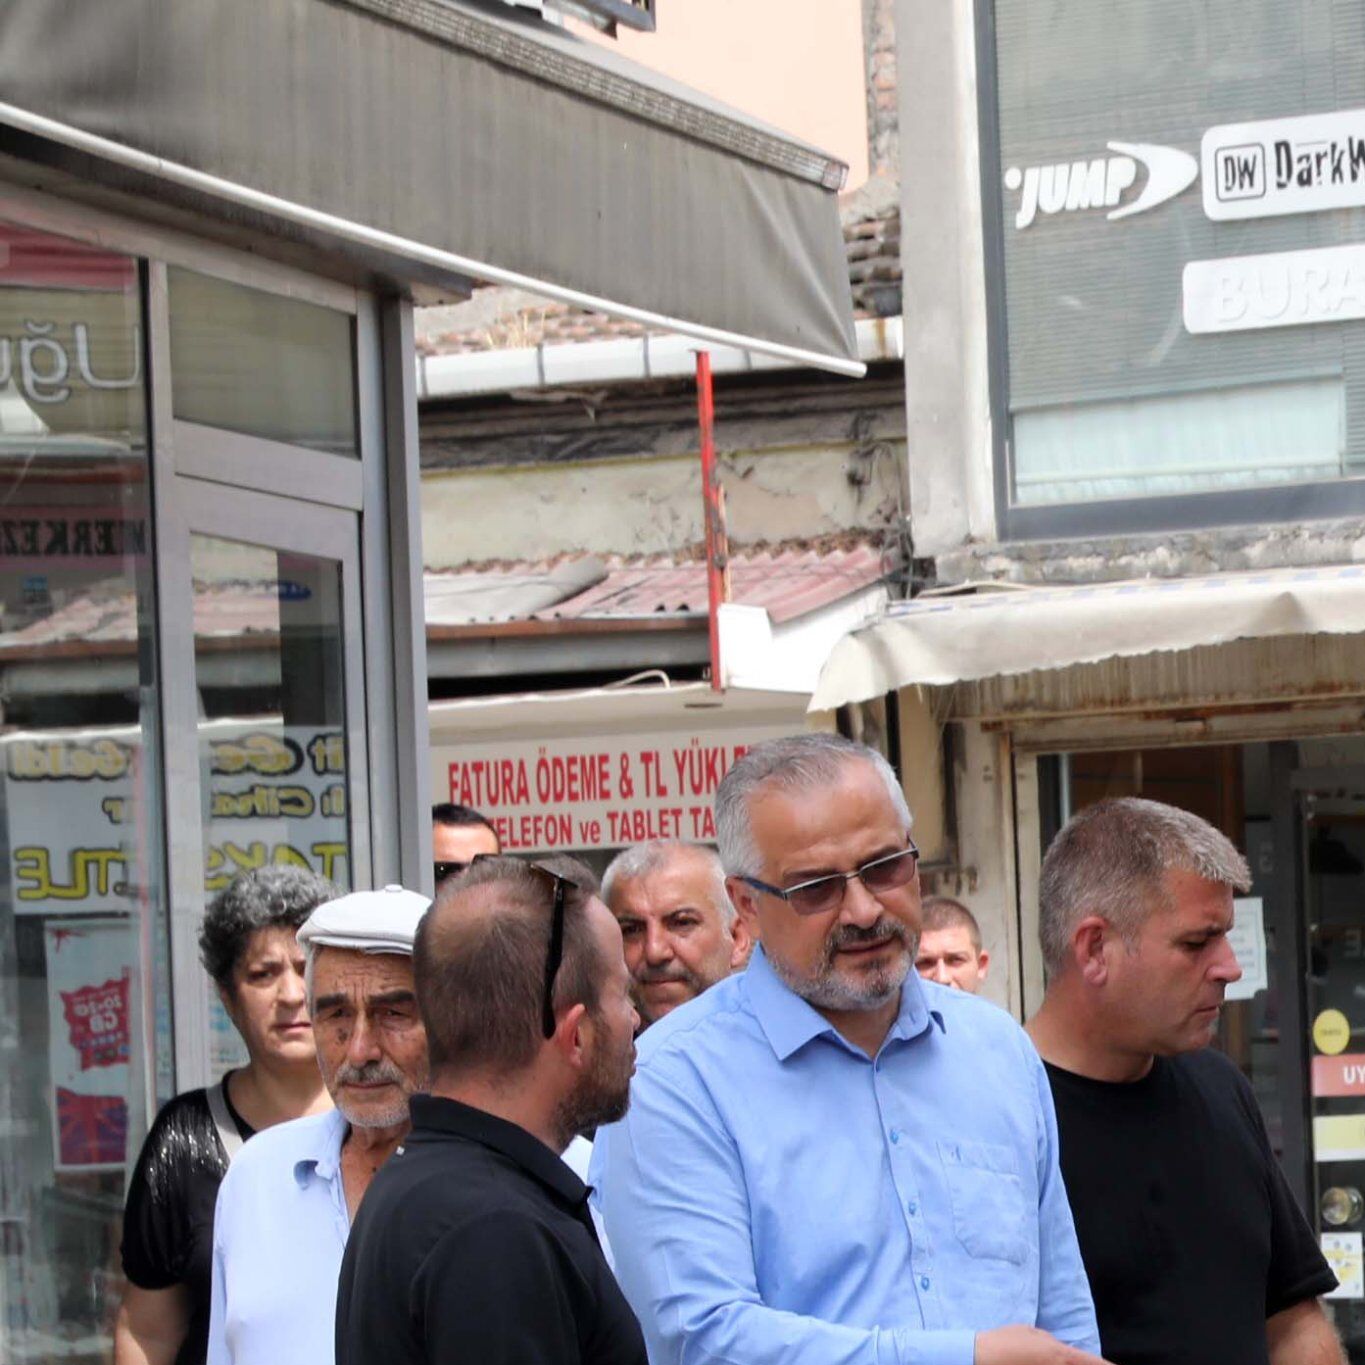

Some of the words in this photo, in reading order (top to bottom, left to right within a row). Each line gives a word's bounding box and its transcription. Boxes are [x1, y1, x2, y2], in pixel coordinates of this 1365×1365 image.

[1223, 153, 1258, 192] DW
[448, 759, 530, 808] FATURA
[536, 746, 611, 803] ÖDEME
[618, 752, 634, 800] &
[640, 751, 667, 798] TL
[491, 814, 573, 848] ELEFON
[578, 819, 601, 844] ve
[606, 807, 683, 843] TABLET
